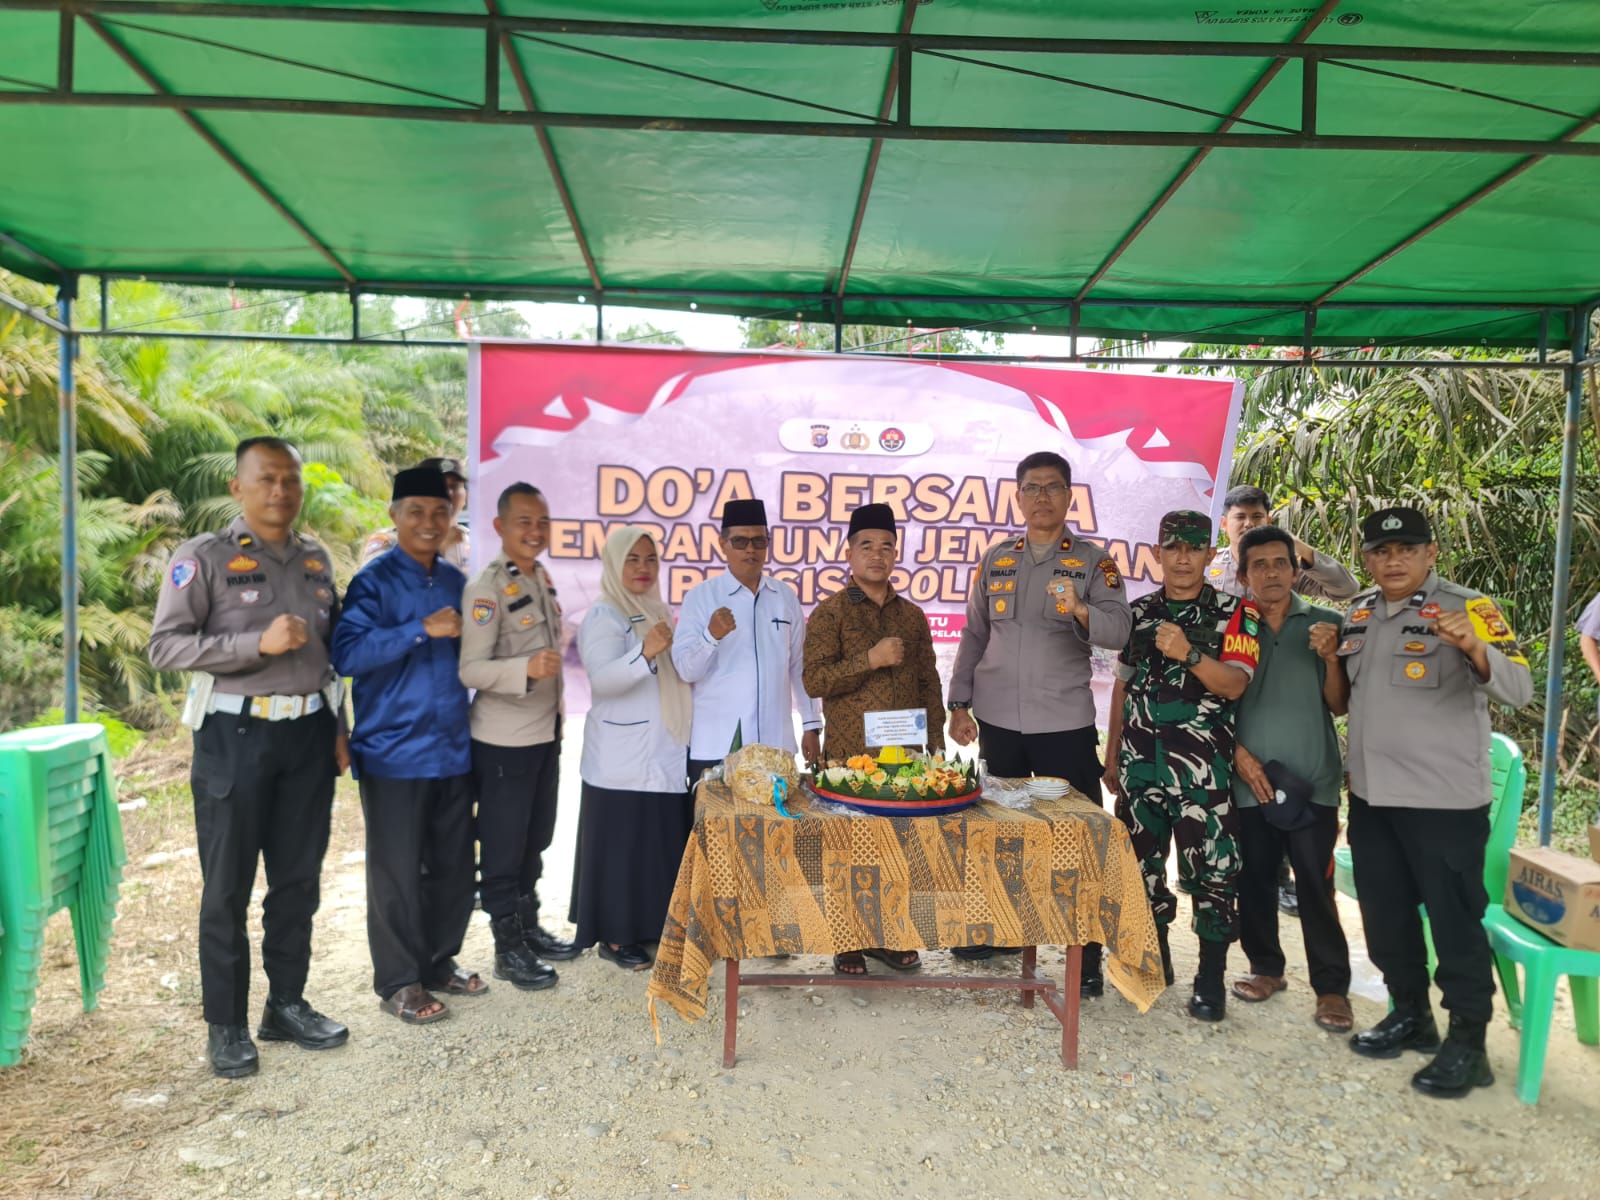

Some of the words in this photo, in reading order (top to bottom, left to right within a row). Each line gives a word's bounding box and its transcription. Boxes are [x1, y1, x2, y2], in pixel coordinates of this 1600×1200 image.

[1053, 569, 1086, 580] POLRI
[928, 616, 949, 627] TU
[1520, 865, 1564, 899] AIRAS
